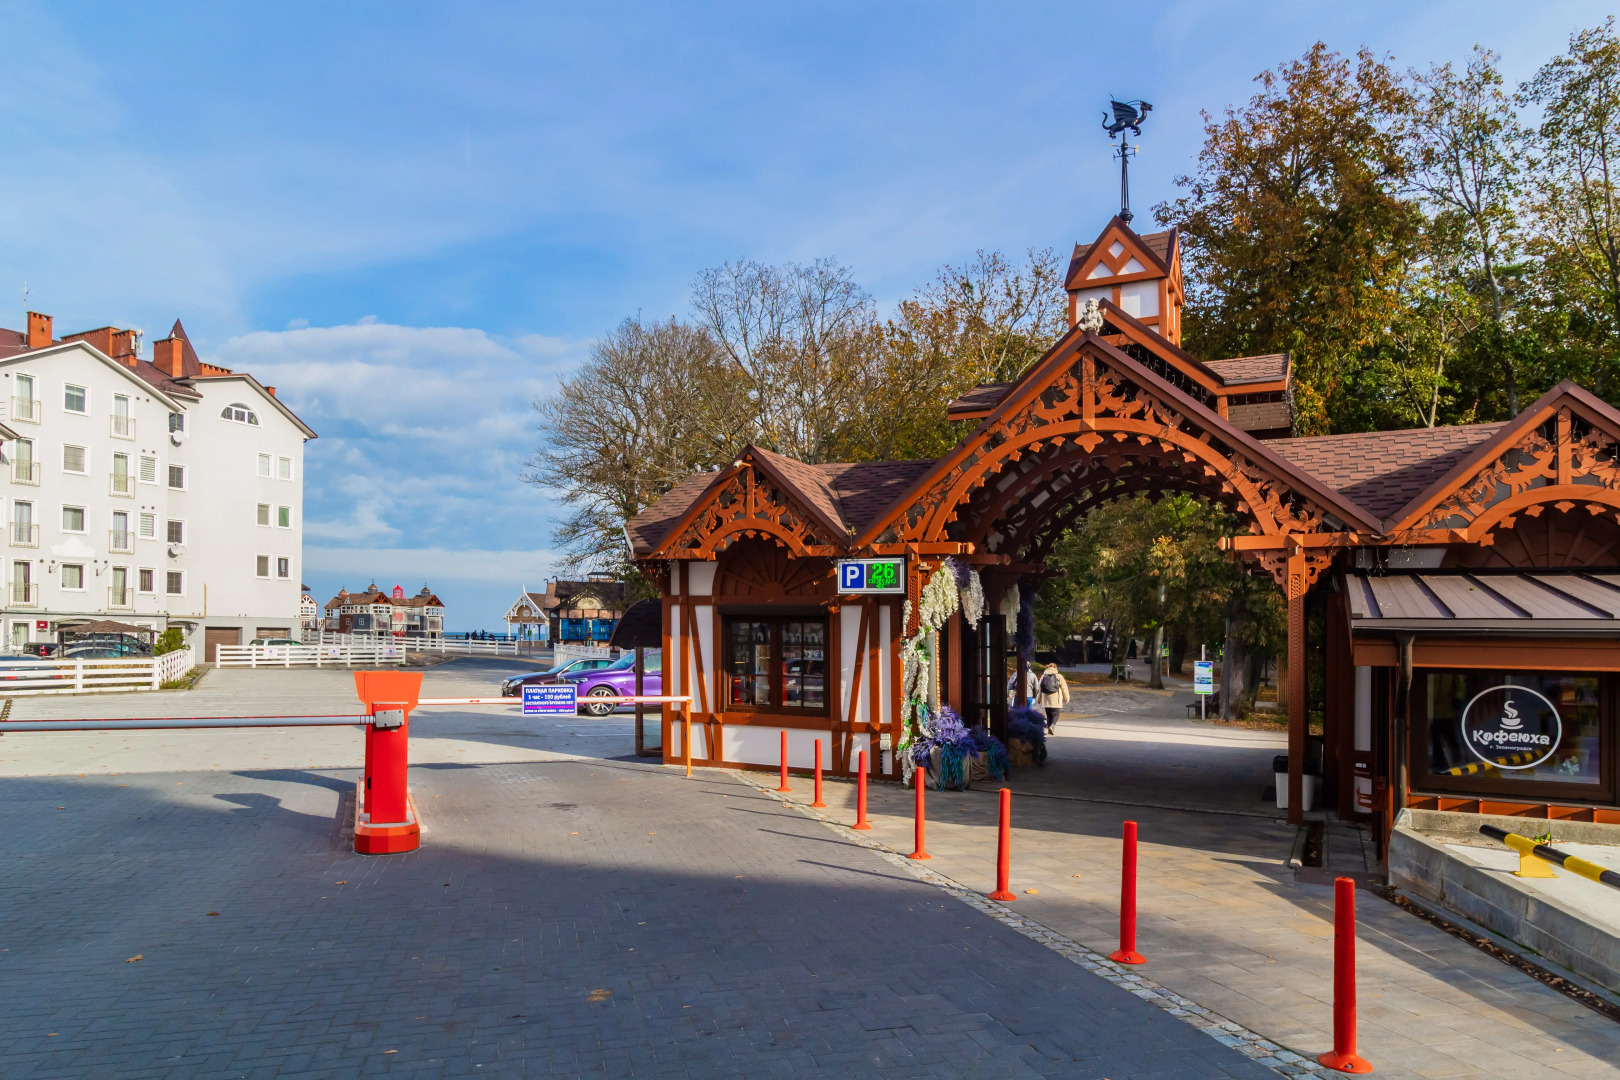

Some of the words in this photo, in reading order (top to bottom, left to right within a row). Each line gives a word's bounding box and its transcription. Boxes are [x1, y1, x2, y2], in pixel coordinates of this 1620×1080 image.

[846, 566, 860, 587] P
[871, 562, 895, 579] 26
[1473, 730, 1550, 745] Кофеюха
